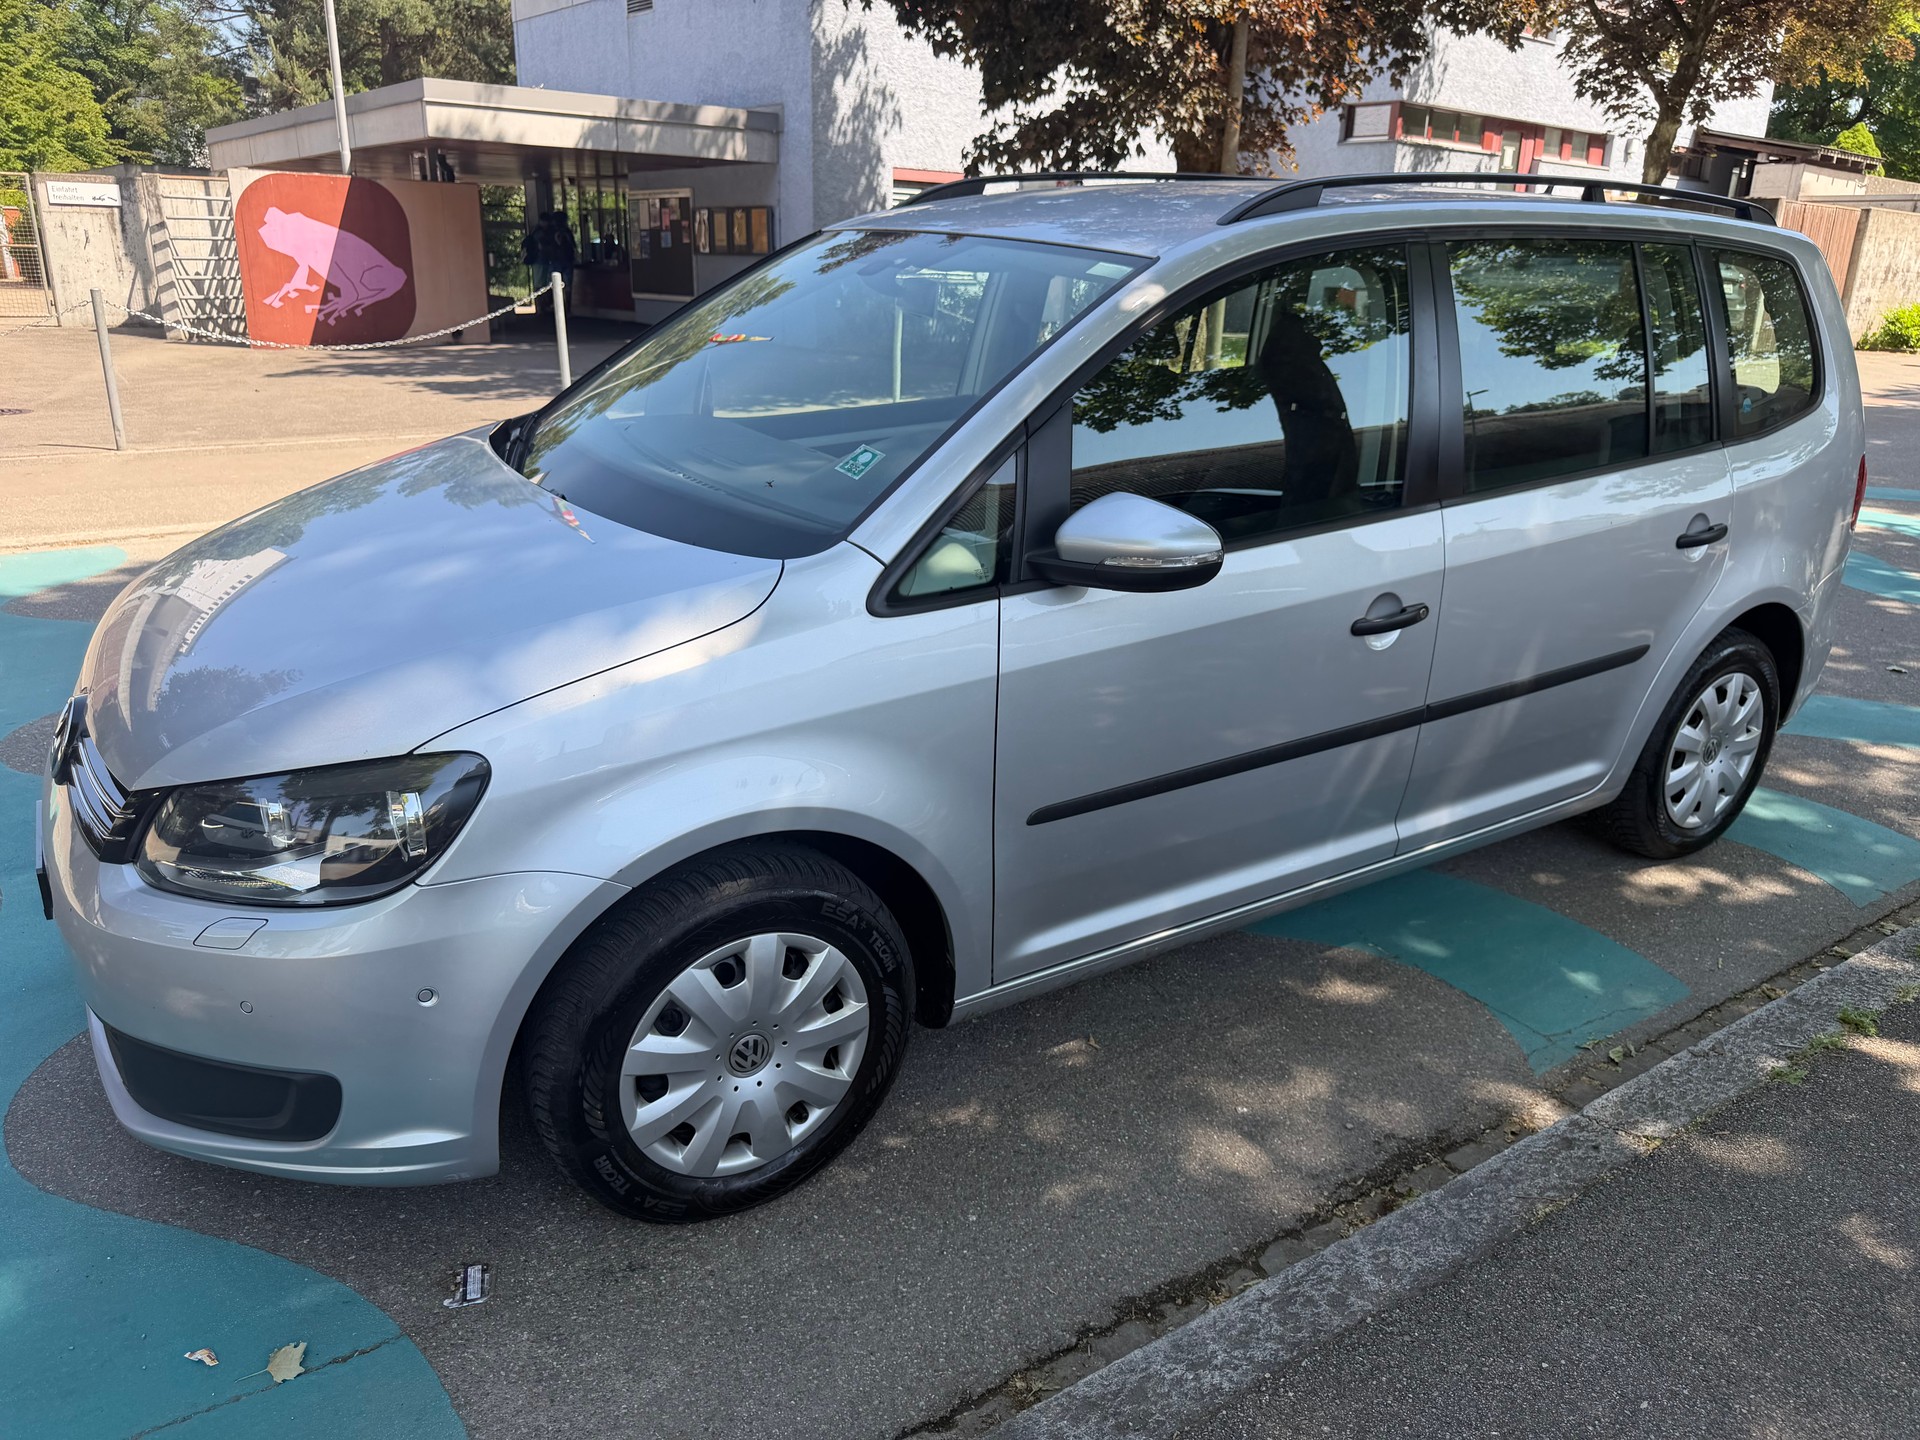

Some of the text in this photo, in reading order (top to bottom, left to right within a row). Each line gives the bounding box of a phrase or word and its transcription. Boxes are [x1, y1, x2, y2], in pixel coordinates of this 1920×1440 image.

[51, 185, 78, 193] Einfahrt
[868, 930, 897, 973] TECAR
[729, 1033, 770, 1073] VW
[593, 1154, 631, 1196] TECAR
